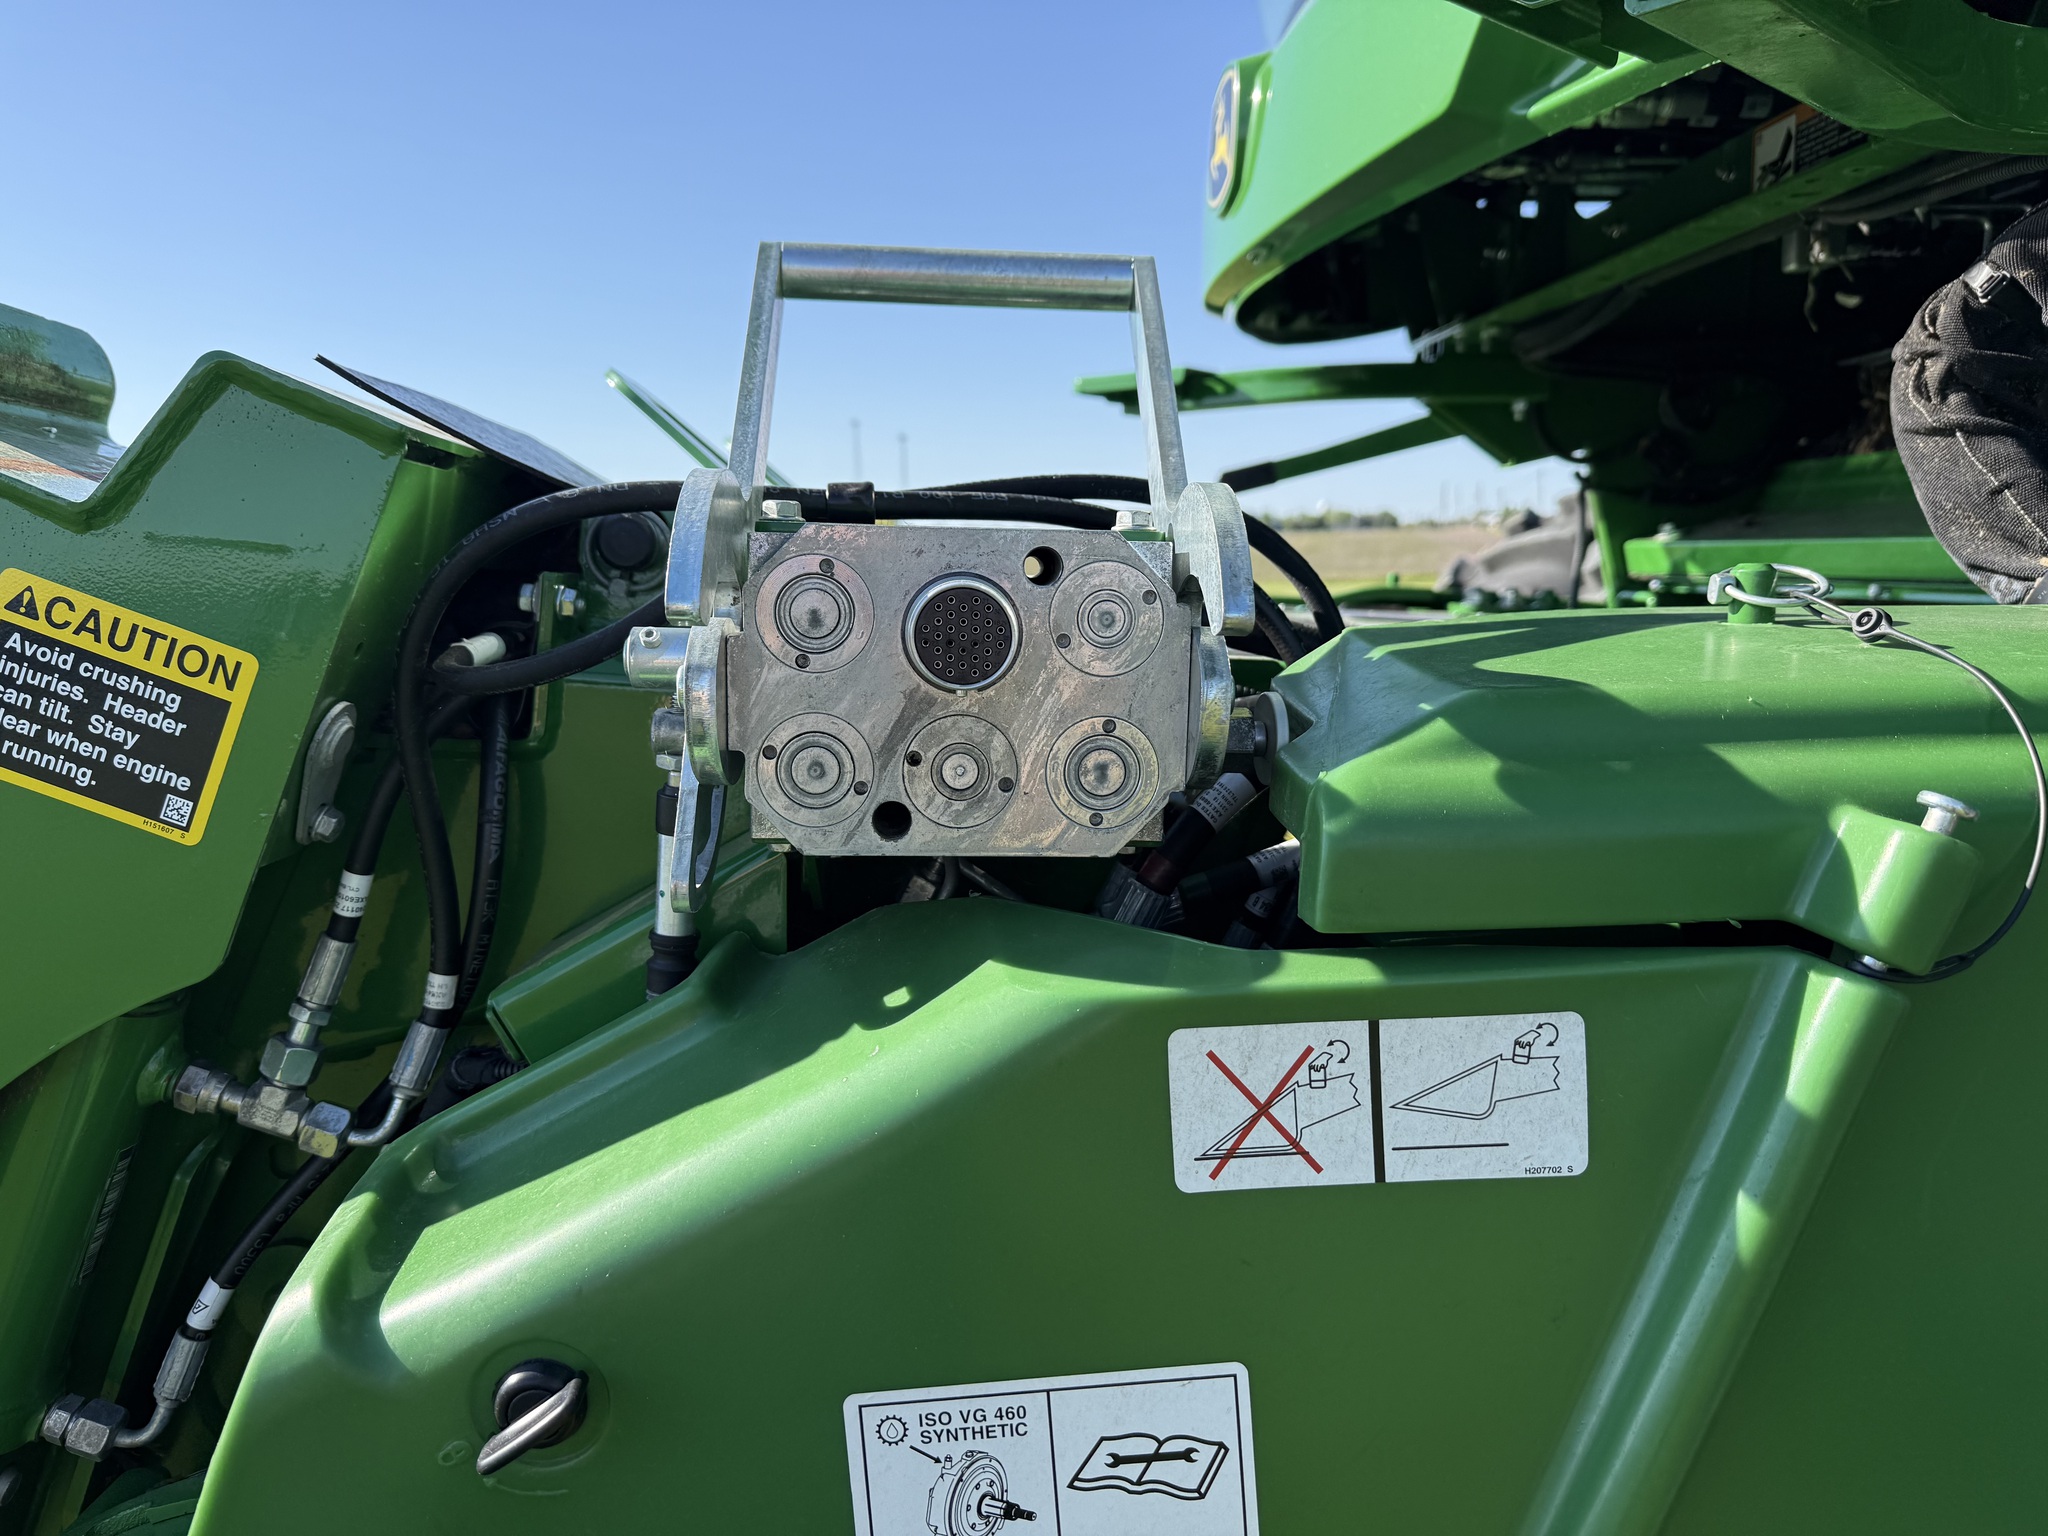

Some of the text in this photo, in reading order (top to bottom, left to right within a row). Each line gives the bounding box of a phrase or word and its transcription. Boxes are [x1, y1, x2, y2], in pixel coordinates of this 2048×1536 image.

[44, 596, 243, 692] CAUTION
[0, 654, 187, 737] injuries. Header
[4, 632, 181, 713] Avoid crushing
[39, 696, 73, 725] tilt.
[88, 714, 140, 750] Stay
[0, 707, 191, 791] lear when engine
[2, 740, 96, 786] running.
[143, 819, 175, 835] H151607
[1525, 1165, 1573, 1174] H207702 S
[919, 1405, 1027, 1427] ISO VG 460
[920, 1422, 1028, 1444] SYNTHETIC
